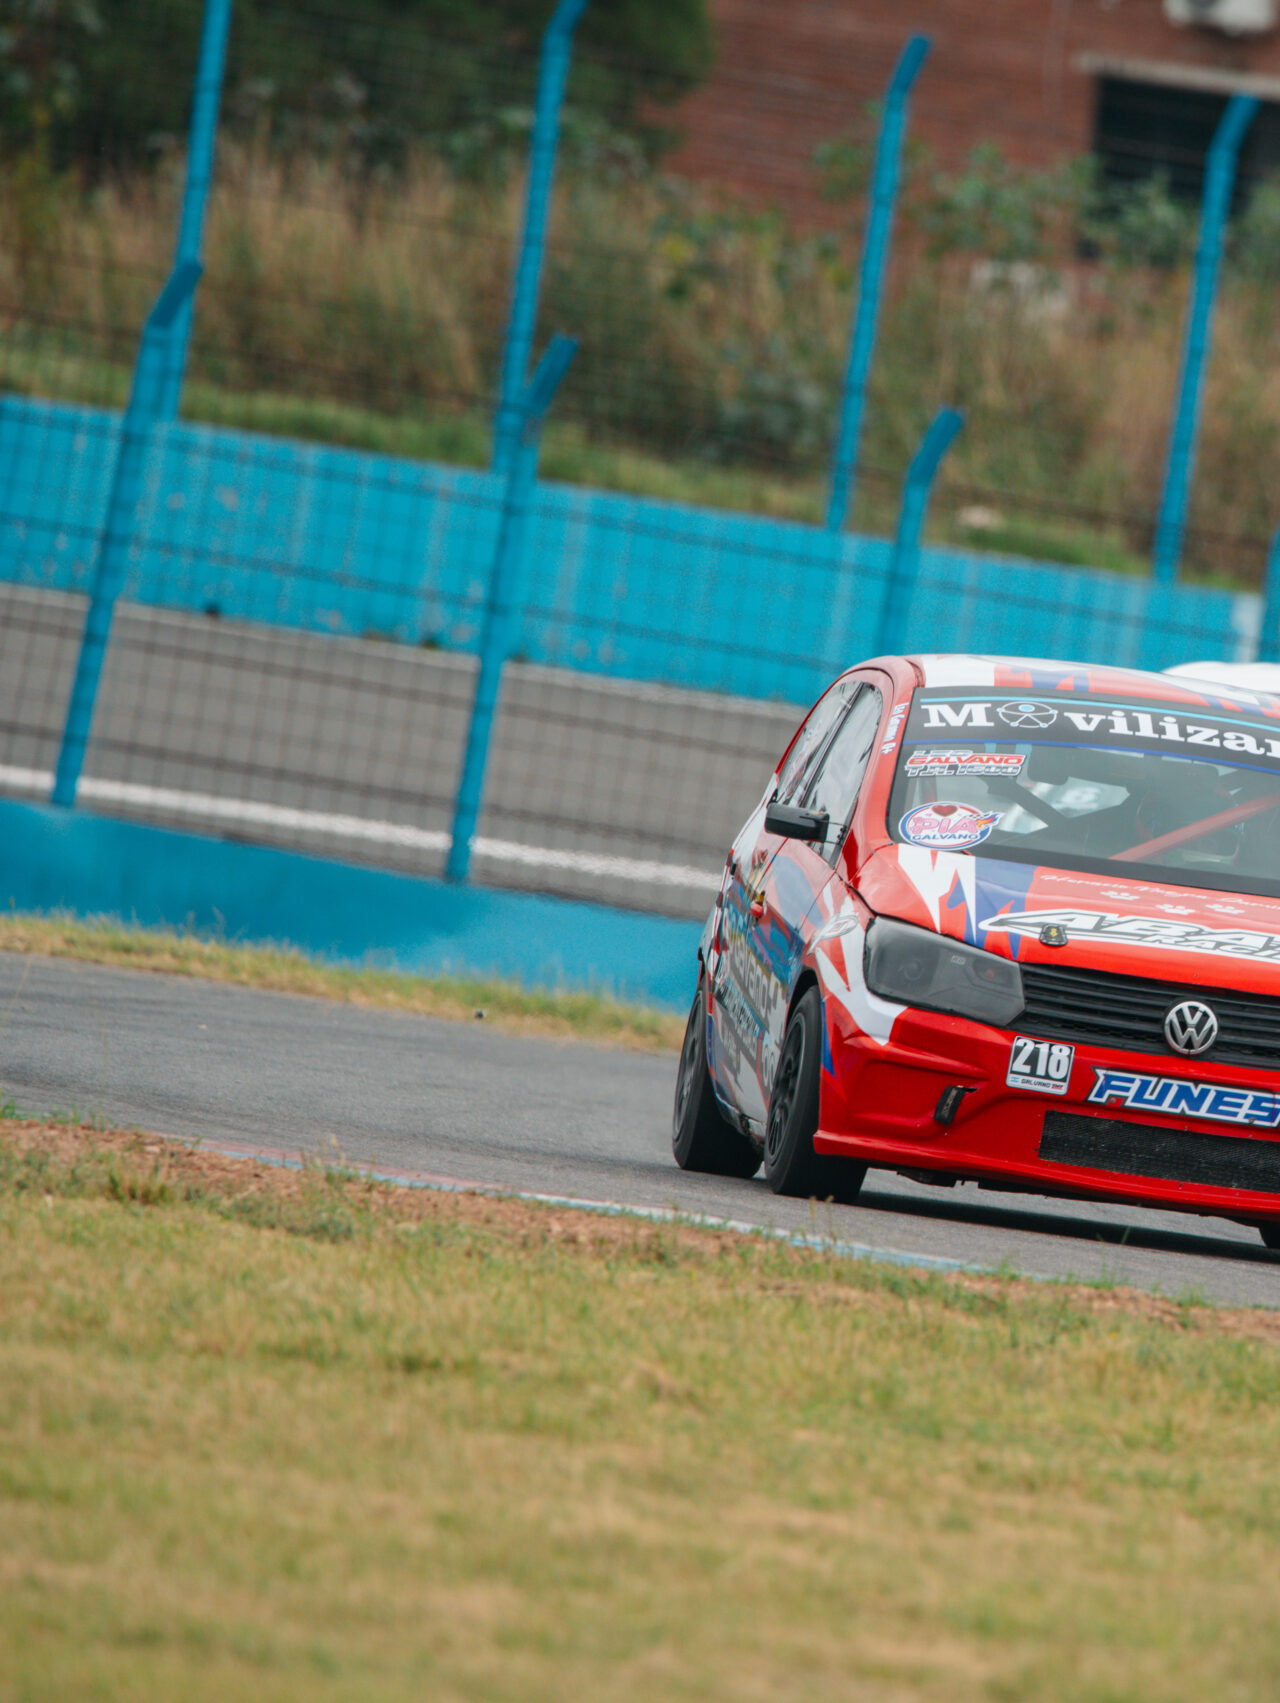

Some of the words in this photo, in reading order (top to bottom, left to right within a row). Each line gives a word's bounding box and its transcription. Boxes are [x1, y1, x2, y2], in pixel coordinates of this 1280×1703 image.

[907, 753, 1026, 766] GALVANO
[910, 817, 980, 835] PIA
[911, 833, 980, 841] GALVANO
[1011, 1038, 1071, 1080] 218
